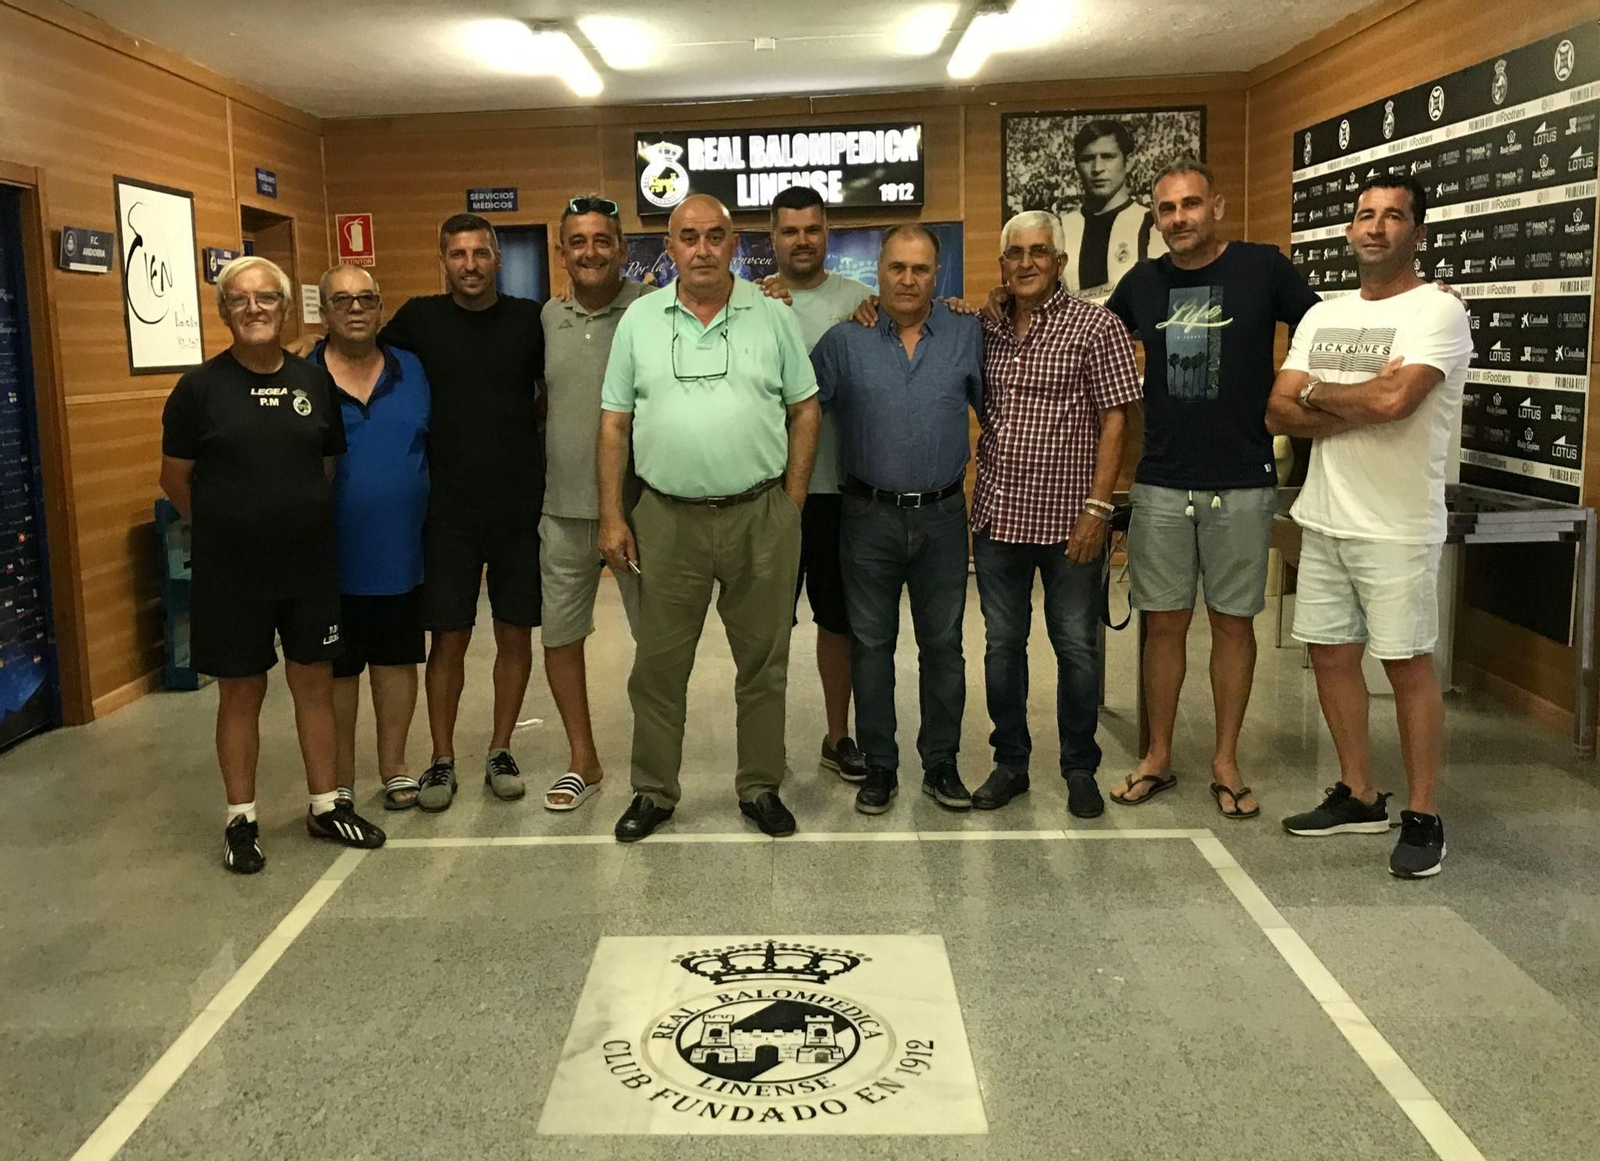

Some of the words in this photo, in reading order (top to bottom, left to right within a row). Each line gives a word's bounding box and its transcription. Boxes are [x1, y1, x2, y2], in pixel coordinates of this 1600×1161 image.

[1533, 130, 1557, 146] LOTUS
[687, 136, 745, 171] REAL
[748, 129, 919, 169] BALOMPEDICA
[1568, 156, 1594, 172] LOTUS
[469, 192, 514, 200] SERVICIOS
[879, 183, 914, 202] 1912
[1532, 221, 1548, 229] PANDA
[1566, 252, 1584, 260] PANDA
[625, 260, 649, 276] Por
[1434, 267, 1454, 278] LOTUS
[1491, 284, 1516, 295] Footters
[1559, 280, 1580, 293] PRIMERA
[1155, 298, 1234, 333] Life
[1309, 343, 1343, 353] JACK
[1351, 344, 1391, 355] JONES
[1489, 350, 1511, 362] LOTUS
[1487, 371, 1512, 384] Footters
[1554, 376, 1575, 389] PRIMERA
[250, 387, 288, 396] LEGEA
[259, 397, 280, 407] P.M
[1517, 407, 1542, 421] LOTUS
[1551, 445, 1578, 460] LOTUS
[1549, 467, 1569, 481] PRIMERA
[651, 1005, 701, 1041] REAL
[716, 988, 885, 1041] BALOMPEDICA
[602, 1038, 652, 1090] CLUB
[648, 1087, 848, 1123] FUNDADO
[853, 1076, 906, 1105] EN
[895, 1038, 935, 1076] 1912
[696, 1075, 837, 1098] LINENSE
